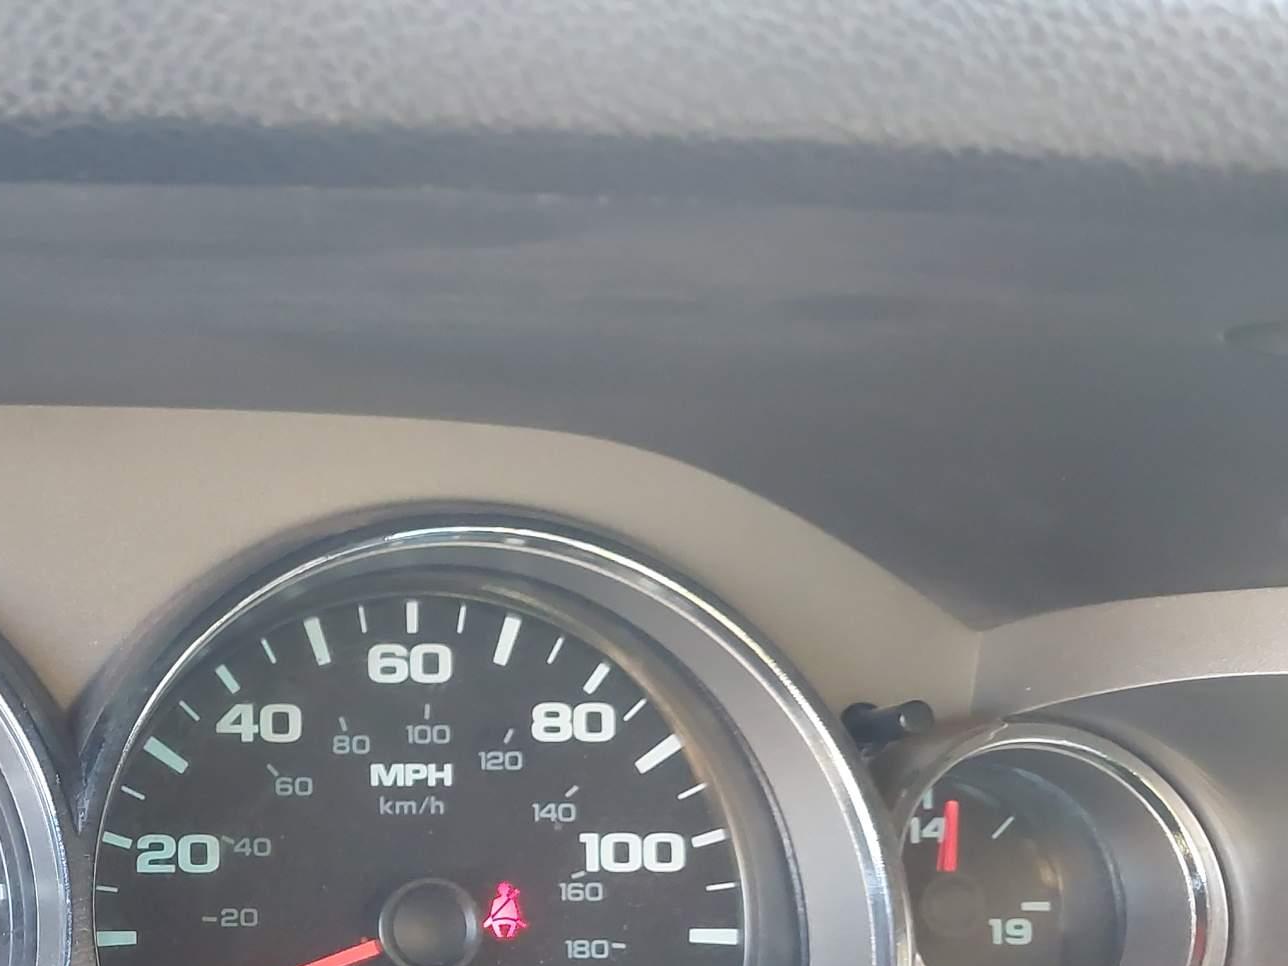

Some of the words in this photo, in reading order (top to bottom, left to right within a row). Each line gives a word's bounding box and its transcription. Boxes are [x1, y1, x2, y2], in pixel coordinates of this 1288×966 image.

[367, 643, 453, 684] 60
[215, 703, 304, 743] 40
[530, 702, 616, 743] 80
[332, 735, 371, 755] 80
[405, 724, 451, 745] 100
[478, 750, 524, 772] 120
[369, 763, 453, 787] MPH
[274, 776, 314, 797] 60
[379, 795, 445, 816] km/h
[532, 802, 577, 823] 140
[136, 833, 221, 875] 20
[233, 836, 272, 857] 40
[579, 832, 686, 873] 100
[559, 881, 604, 902] 160
[220, 907, 259, 928] 20
[988, 917, 1034, 946] 19
[565, 939, 610, 960] 180
